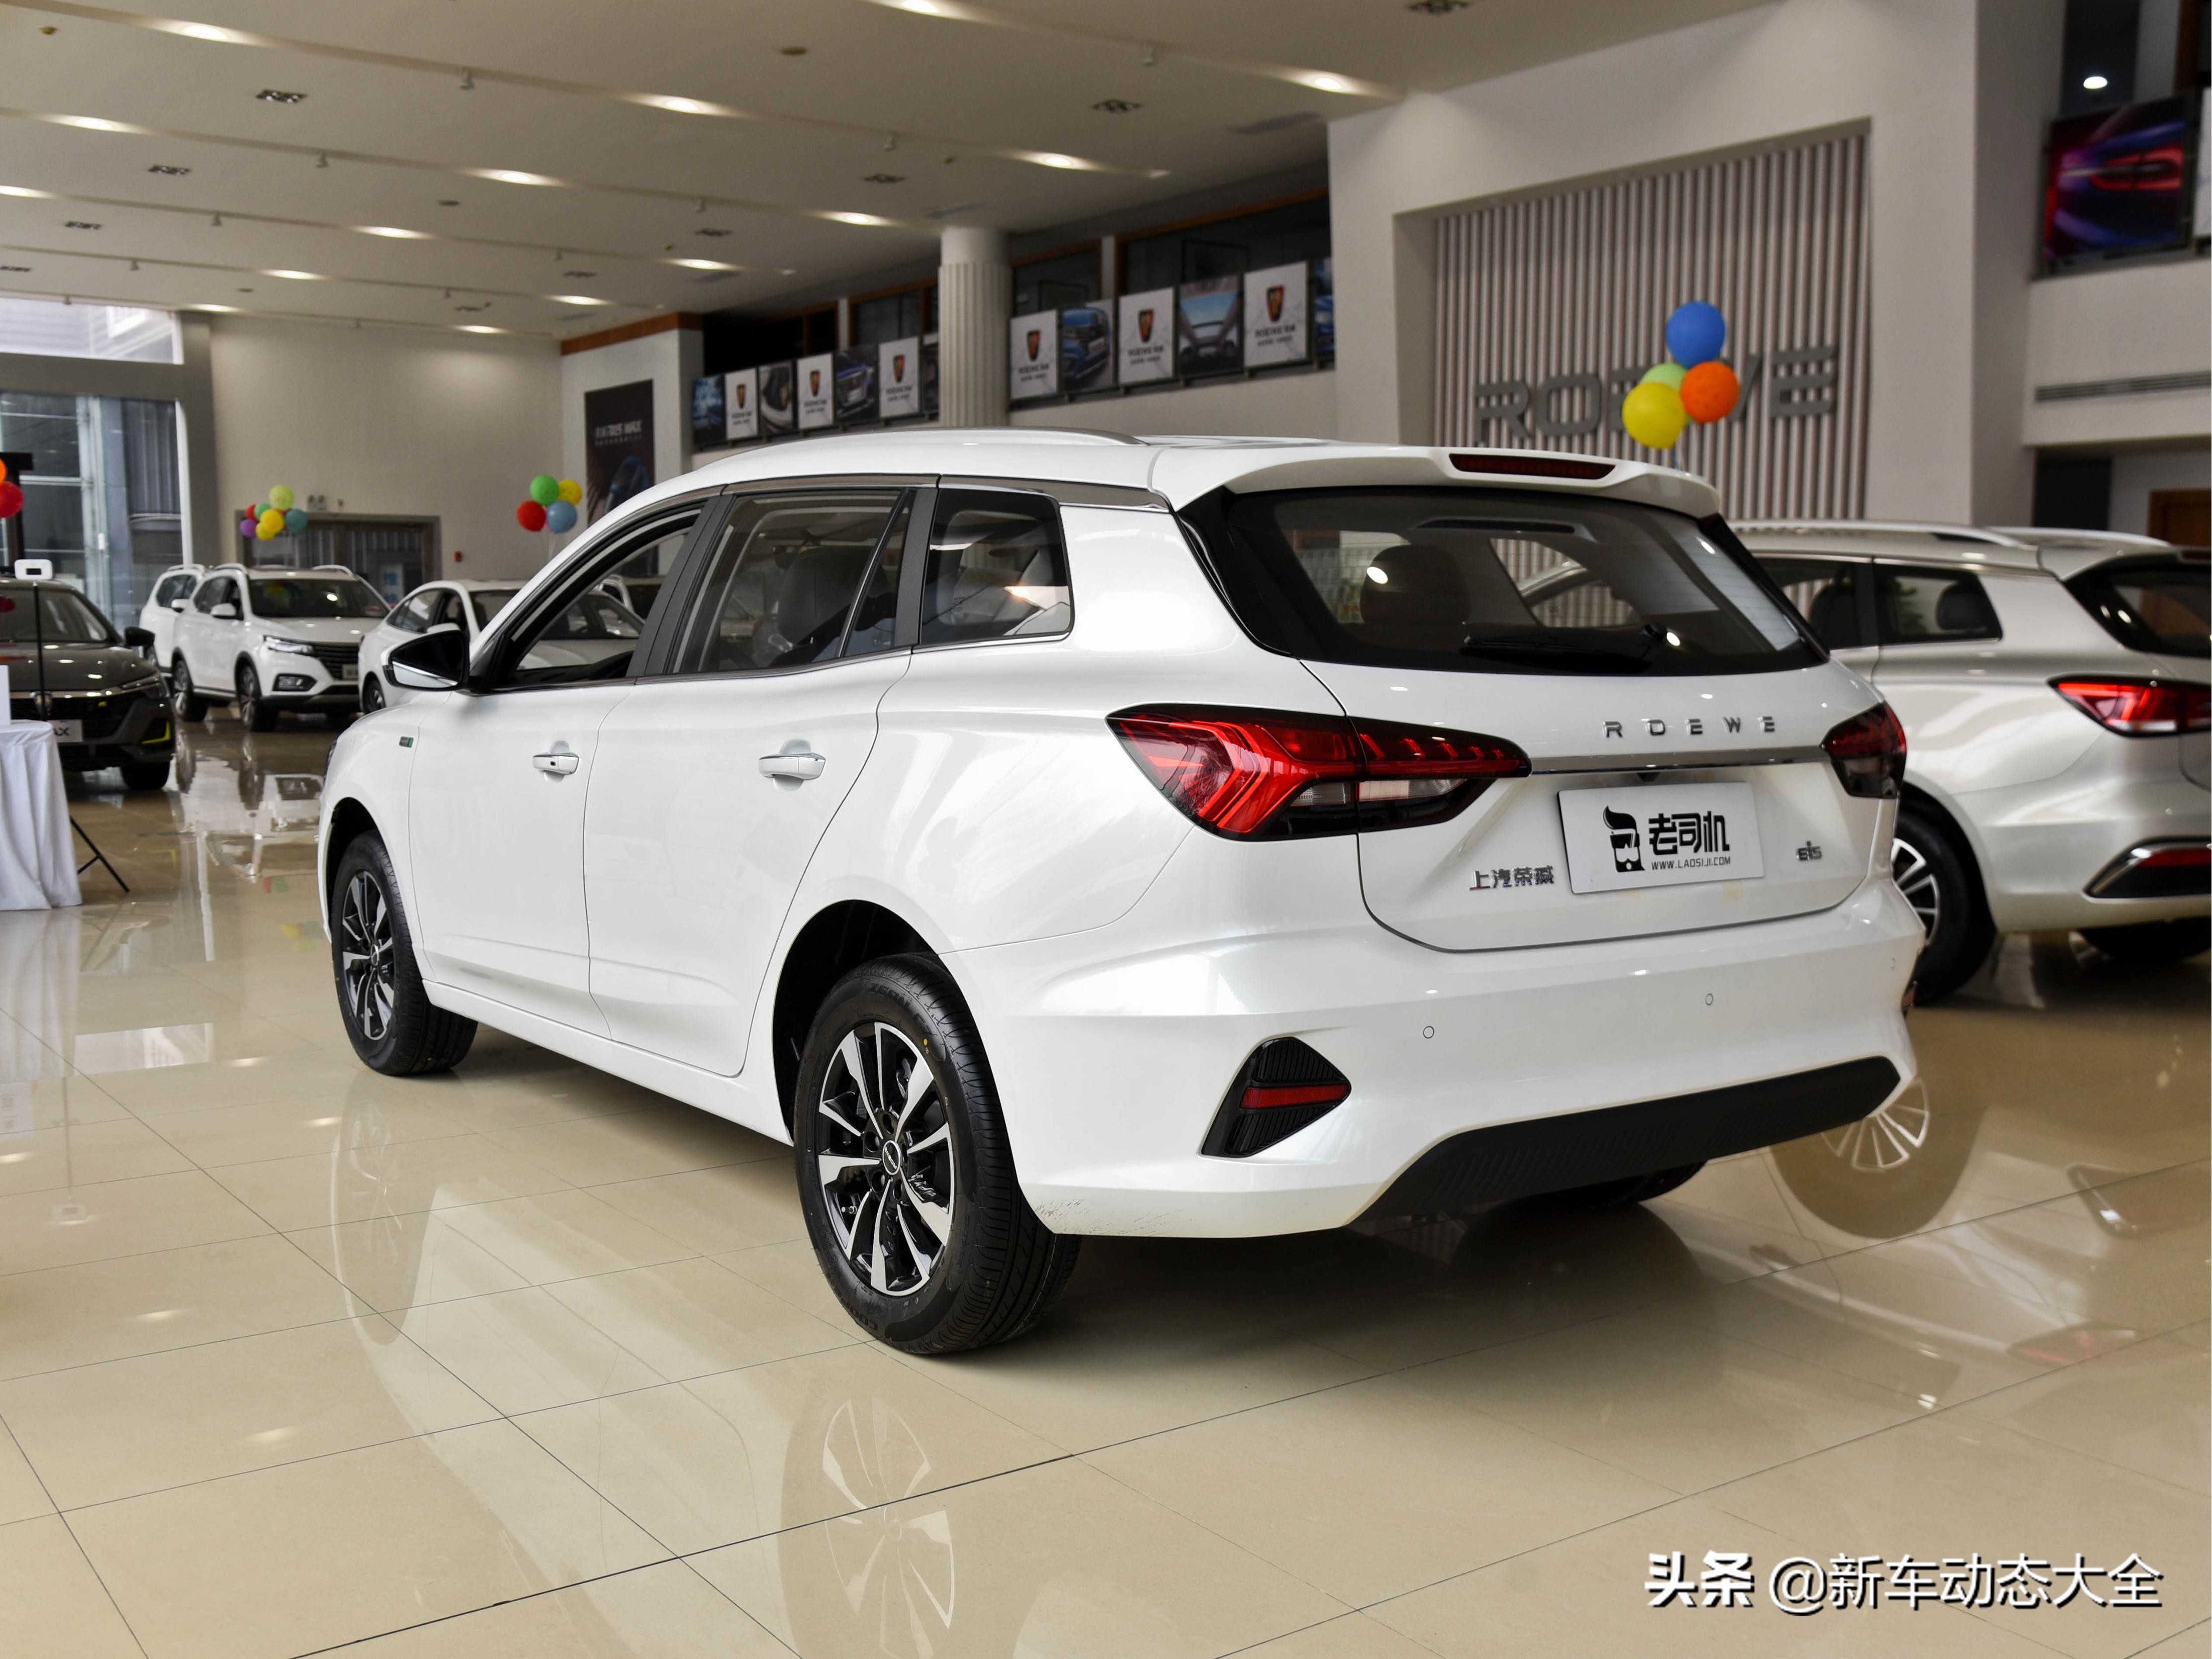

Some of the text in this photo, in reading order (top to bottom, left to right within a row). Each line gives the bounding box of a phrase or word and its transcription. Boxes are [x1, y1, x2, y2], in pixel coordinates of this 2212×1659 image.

[1602, 715, 1776, 739] ROEWE
[1648, 810, 1730, 855] 老司机
[1651, 856, 1731, 870] WWW.LAOSIJI.COM
[1469, 865, 1554, 891] 上汽荣威
